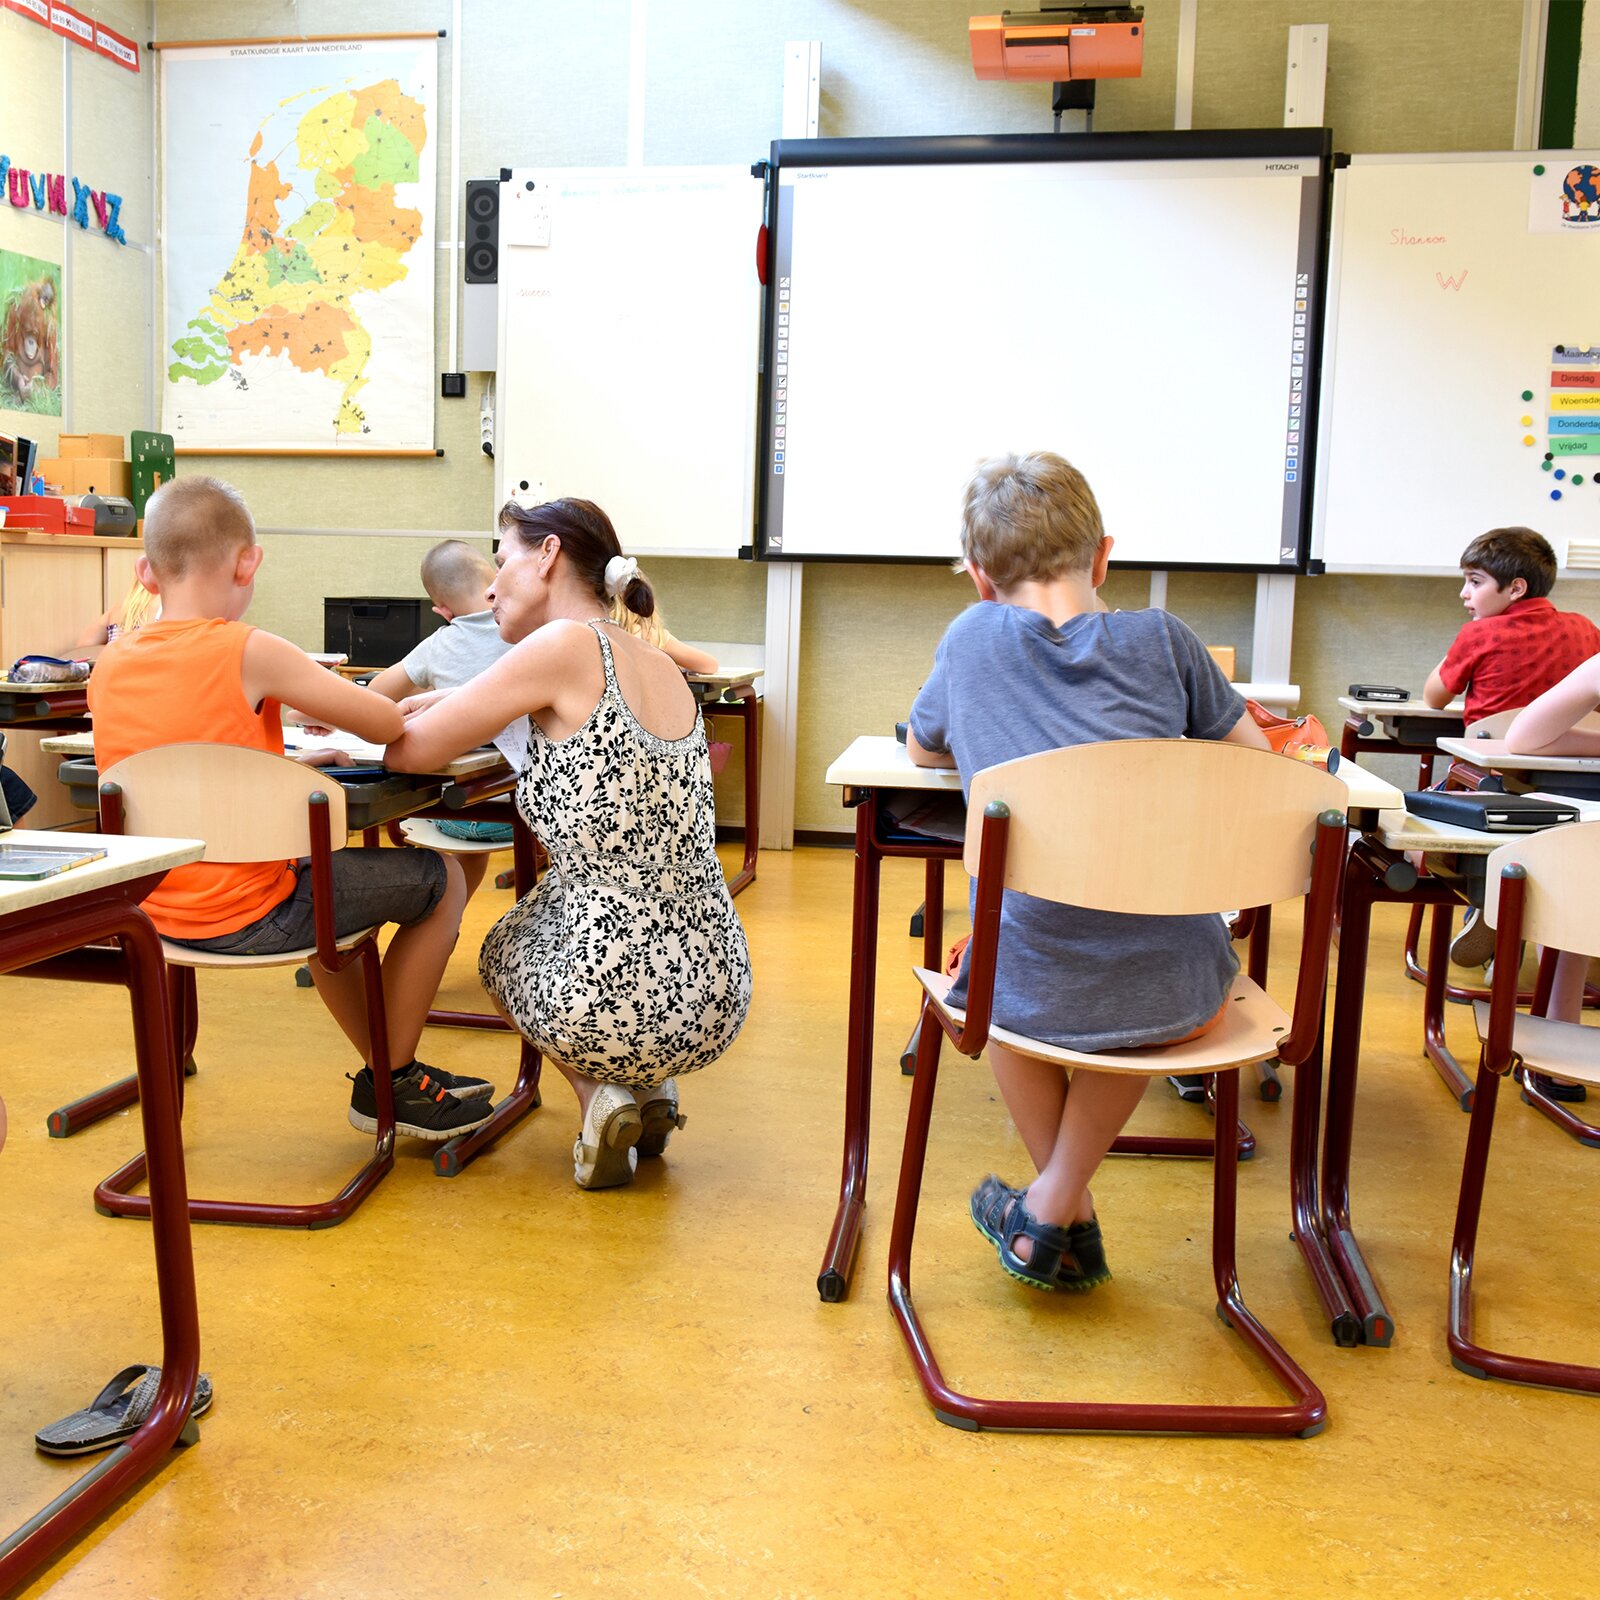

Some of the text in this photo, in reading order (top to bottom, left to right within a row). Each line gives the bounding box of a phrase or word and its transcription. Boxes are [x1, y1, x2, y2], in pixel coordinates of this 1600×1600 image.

[230, 44, 363, 56] STAATKUNDIGE KAART VAN NEDERLAND
[1265, 163, 1299, 171] HITACHI
[1435, 269, 1468, 292] W
[1561, 374, 1595, 384] Dinsdag
[1560, 397, 1600, 405] Woensda
[1558, 442, 1587, 451] Vrijdag
